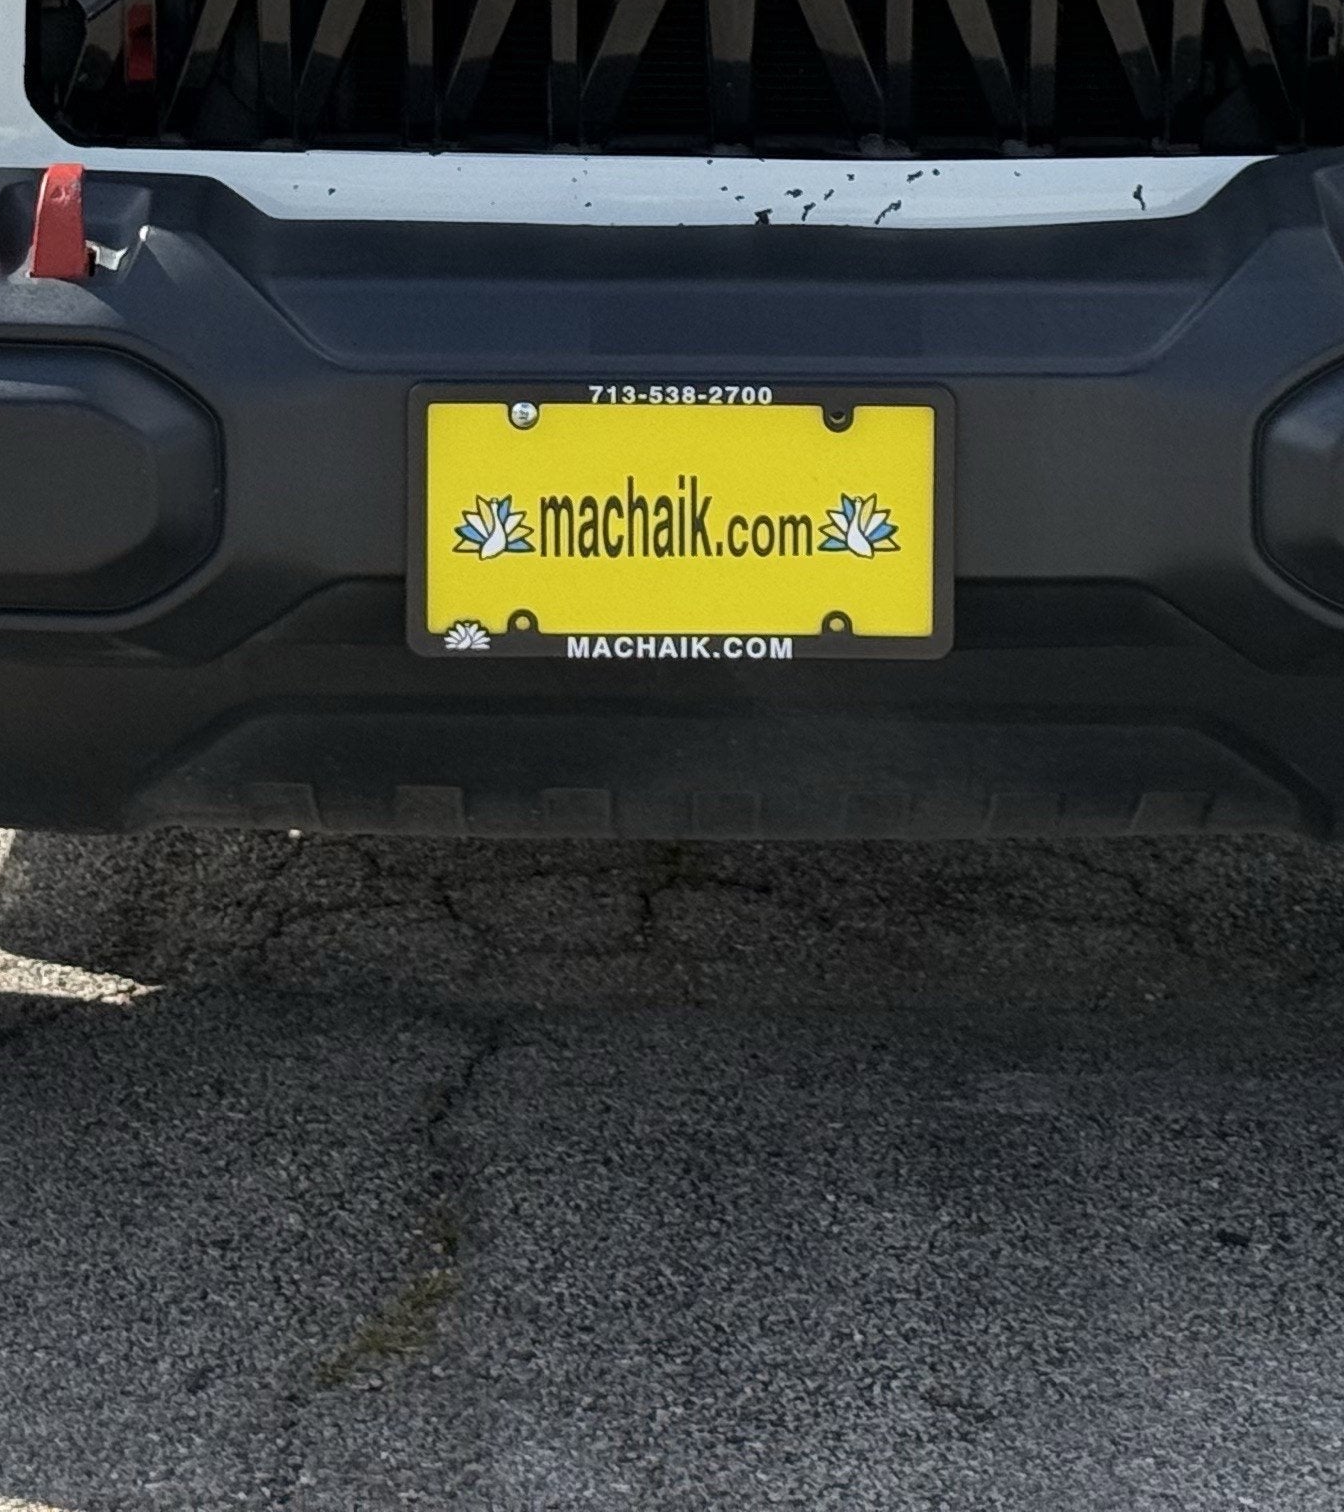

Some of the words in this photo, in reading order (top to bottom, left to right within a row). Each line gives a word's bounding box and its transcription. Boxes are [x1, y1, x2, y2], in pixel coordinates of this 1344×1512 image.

[588, 385, 773, 404] 713-538-2700
[540, 474, 813, 558] machaik.com
[567, 636, 793, 659] MACHAIK.COM
